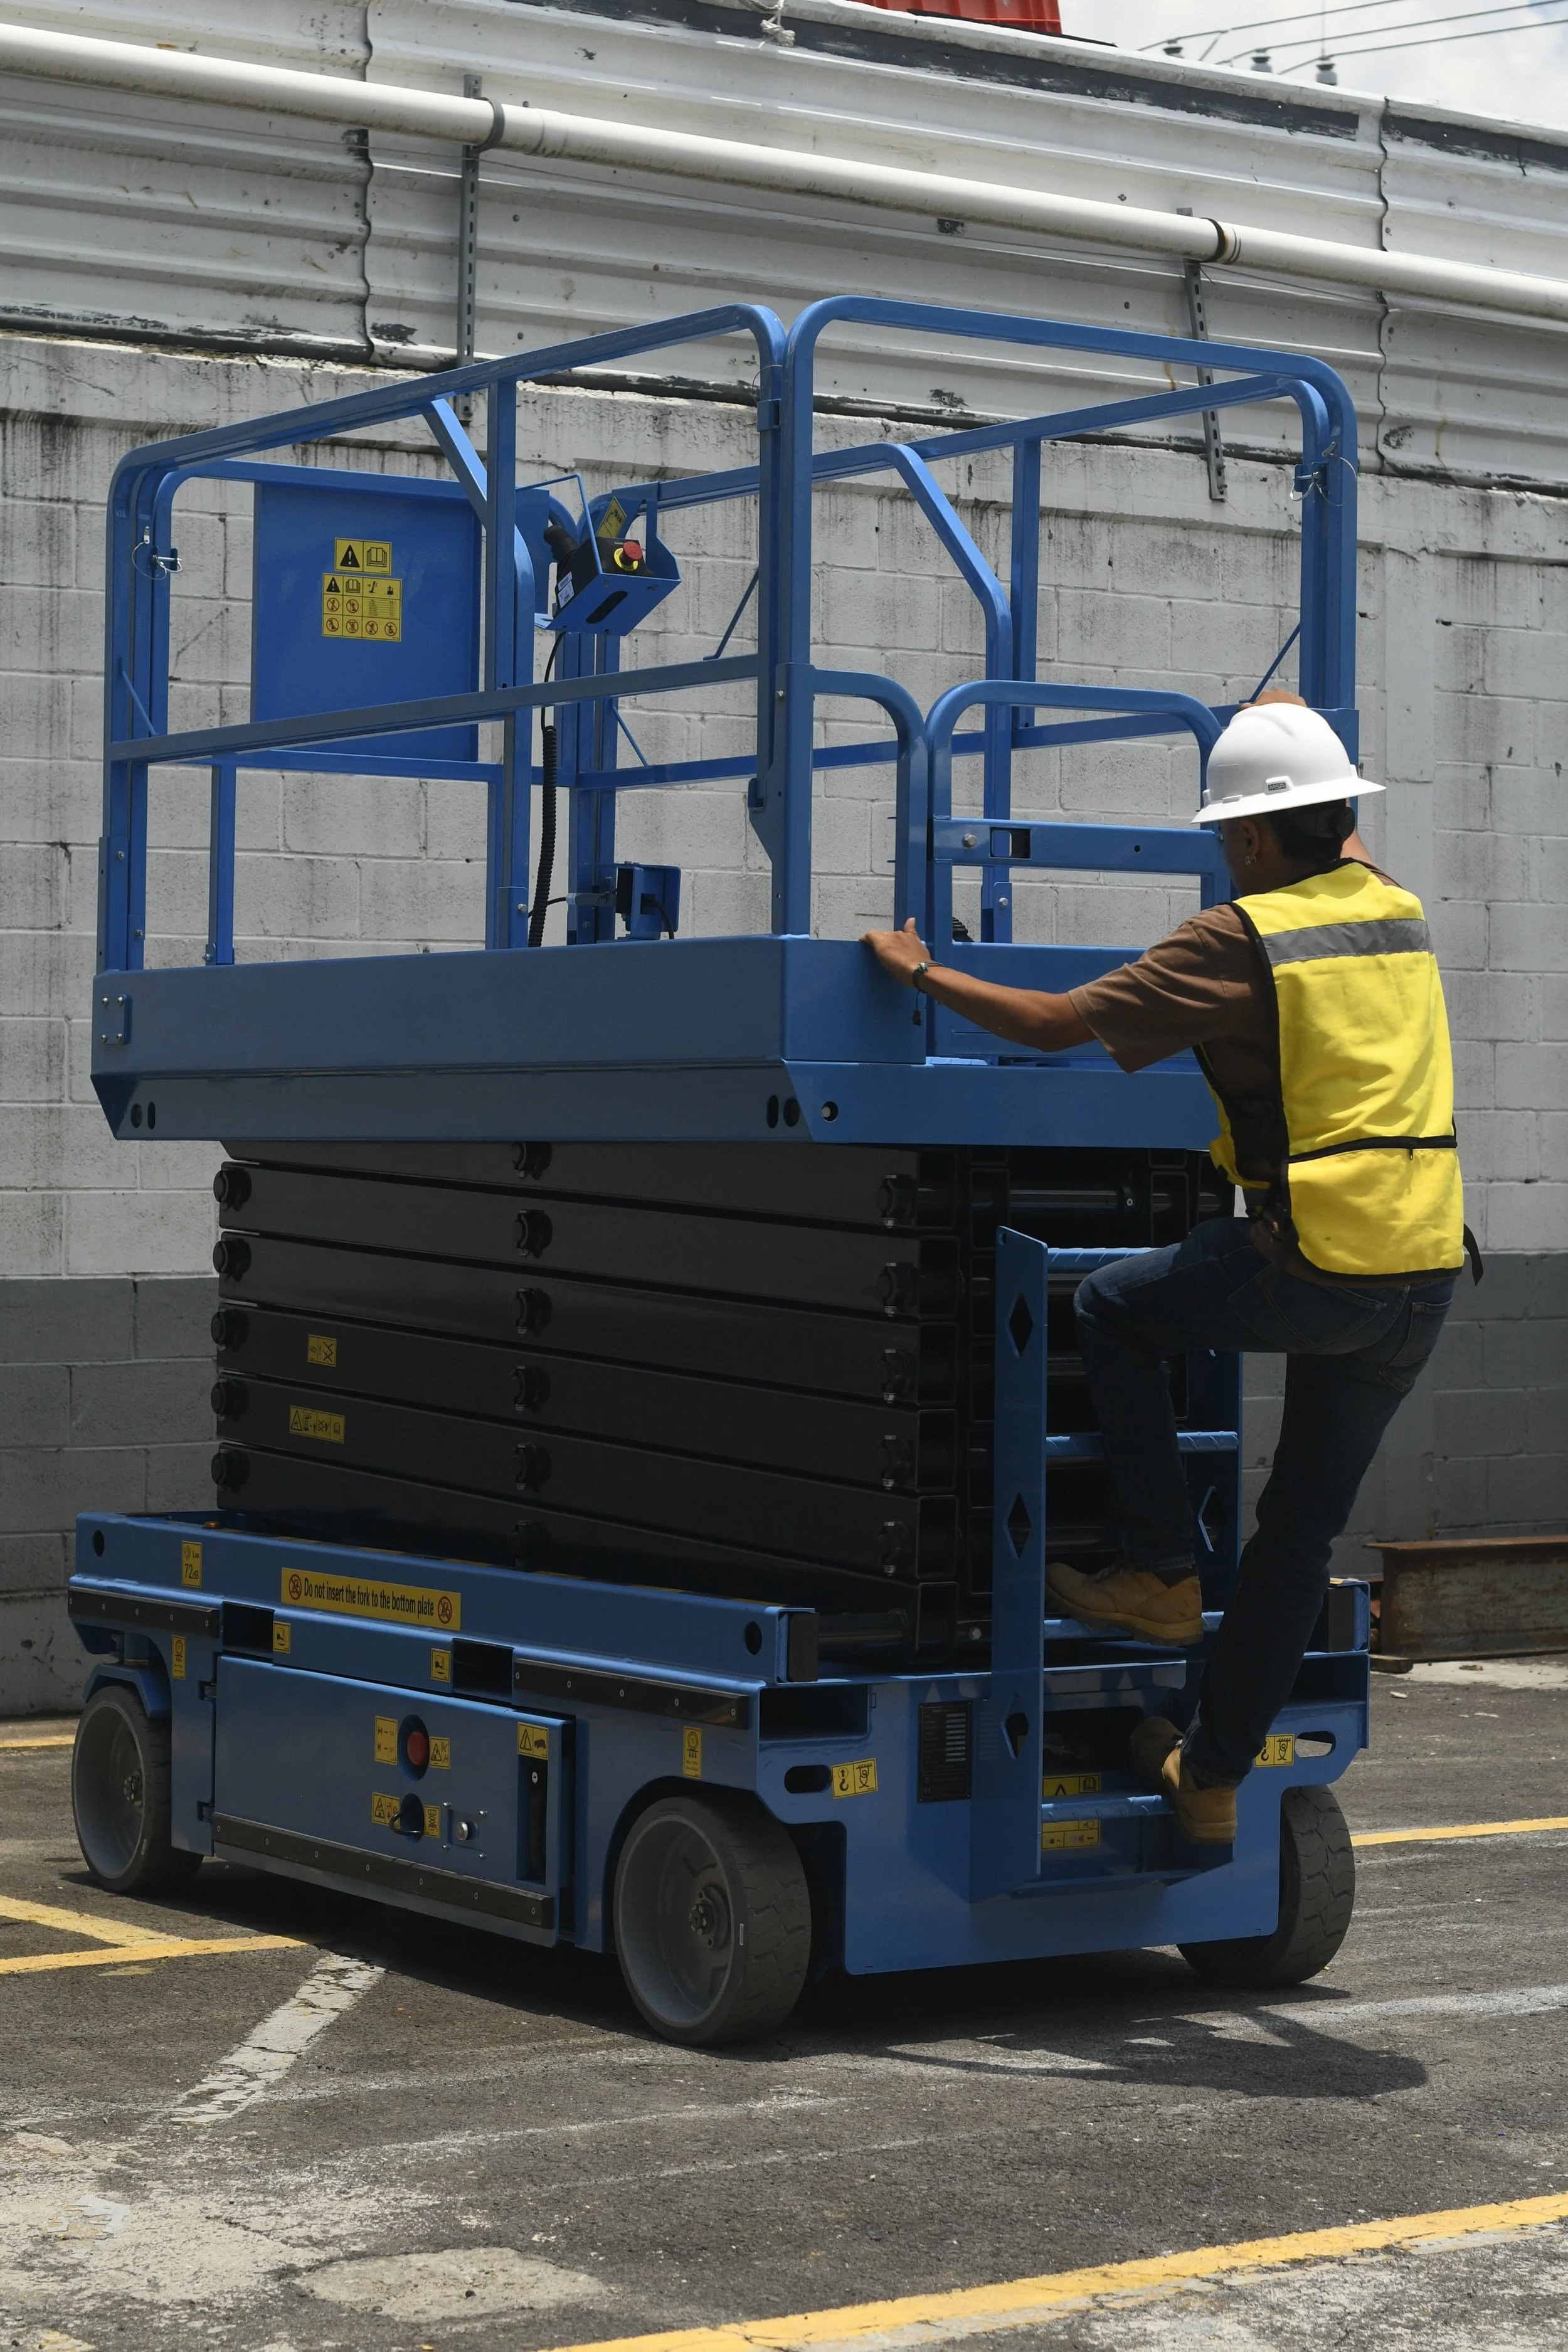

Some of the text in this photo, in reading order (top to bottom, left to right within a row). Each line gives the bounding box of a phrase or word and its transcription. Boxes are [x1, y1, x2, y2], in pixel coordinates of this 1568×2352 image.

[305, 1578, 434, 1618] Do not insert the fork to the bottom plate
